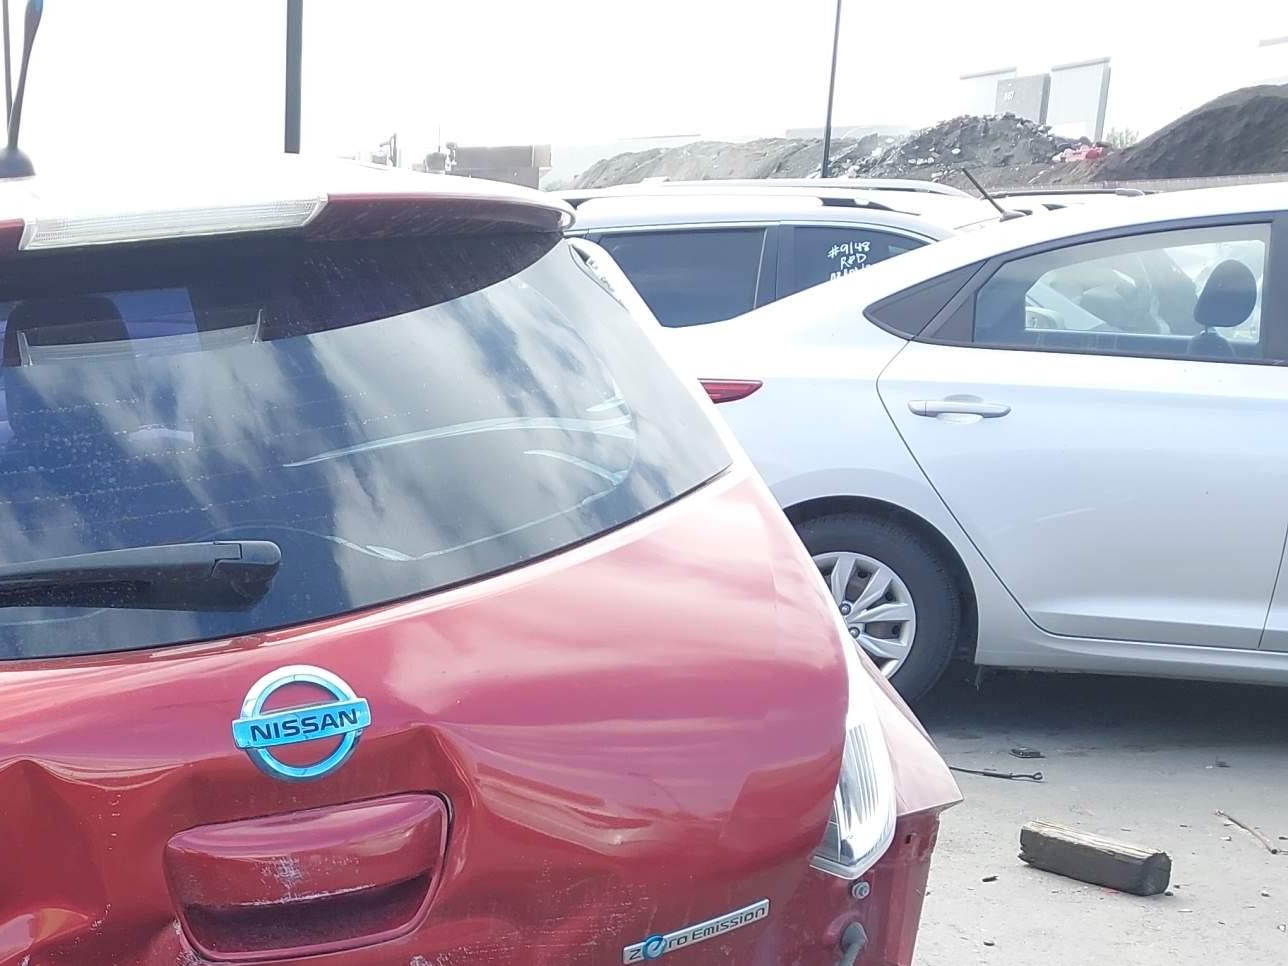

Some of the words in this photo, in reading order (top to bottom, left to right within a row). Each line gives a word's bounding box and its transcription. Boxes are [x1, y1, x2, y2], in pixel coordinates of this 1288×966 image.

[827, 241, 871, 259] #9148
[249, 708, 358, 743] NISSAN
[691, 906, 766, 941] Emission
